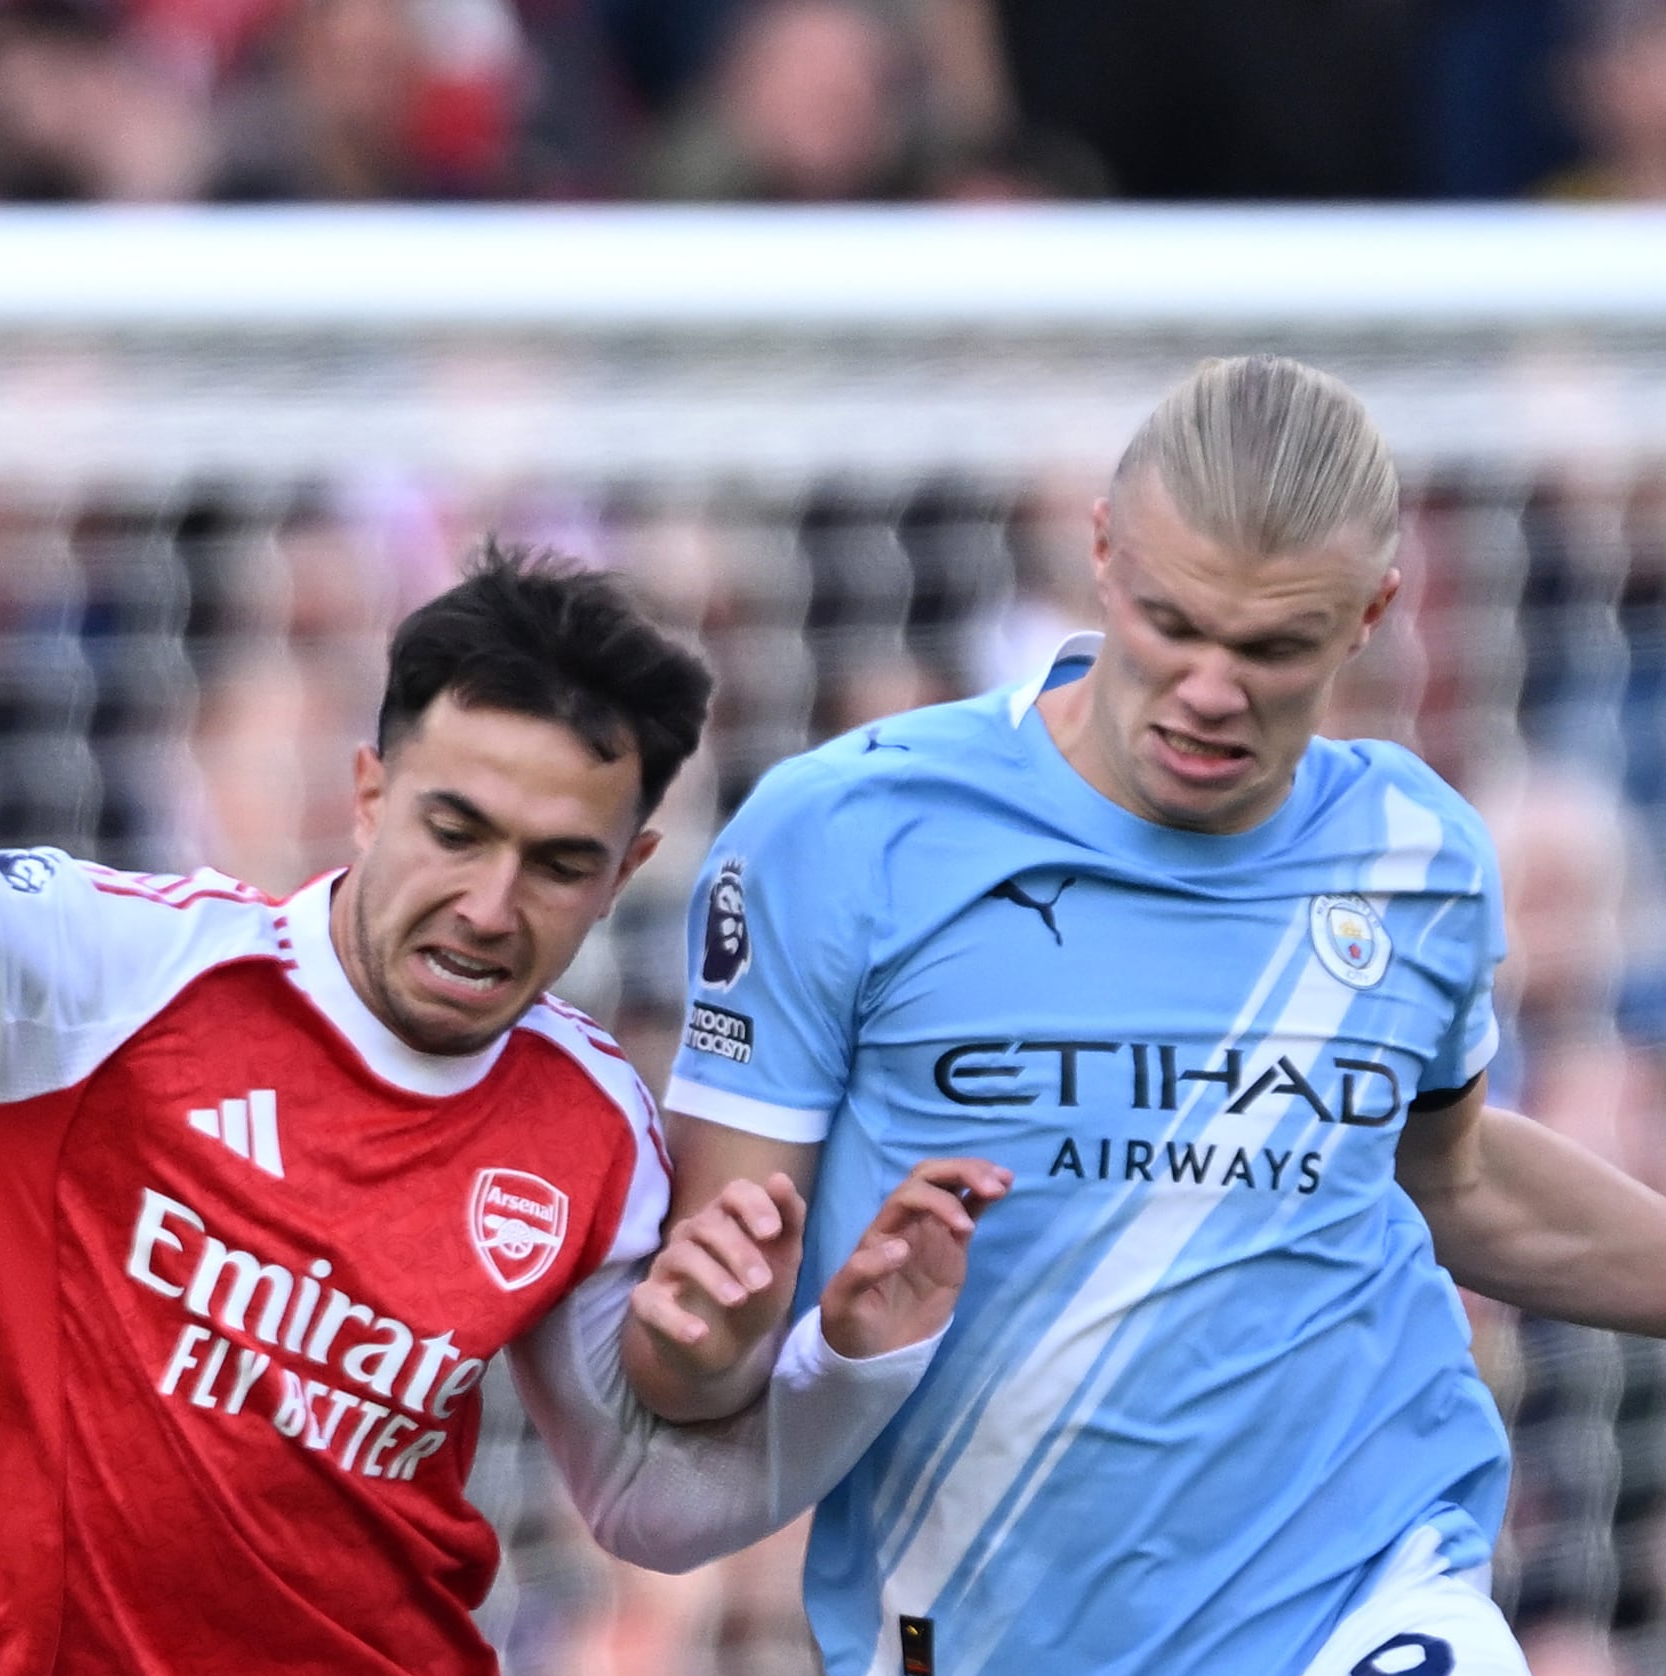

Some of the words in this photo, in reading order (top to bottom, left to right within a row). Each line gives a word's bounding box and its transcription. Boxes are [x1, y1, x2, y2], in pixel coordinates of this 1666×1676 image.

[933, 1040, 1401, 1127] ETIHAD
[486, 1185, 554, 1222] Arsenal
[1048, 1136, 1321, 1194] AIRWAYS
[127, 1187, 486, 1420] Emirate
[159, 1323, 271, 1415] FLY
[273, 1368, 447, 1481] BETTER
